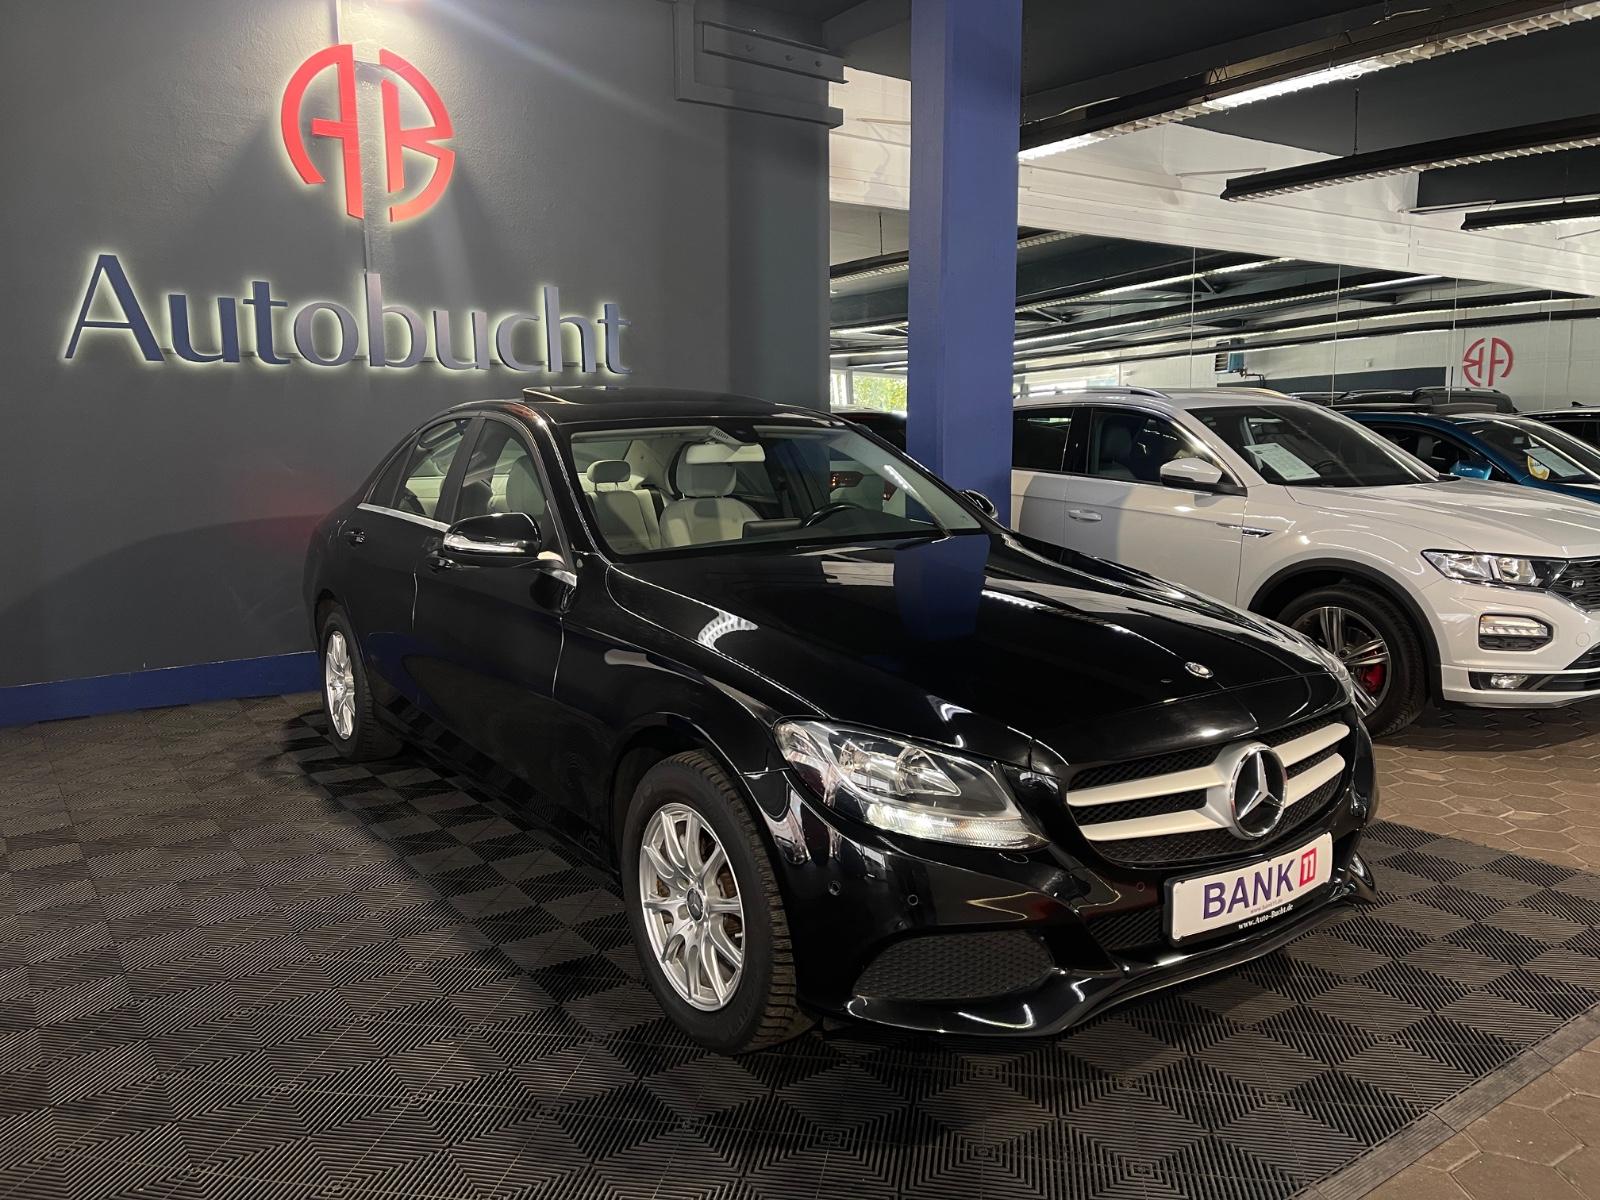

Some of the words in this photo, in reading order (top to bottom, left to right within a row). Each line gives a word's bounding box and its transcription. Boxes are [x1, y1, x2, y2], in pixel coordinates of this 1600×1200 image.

[281, 44, 456, 223] AB
[63, 254, 632, 375] Autobucht
[1203, 859, 1295, 920] BANK
